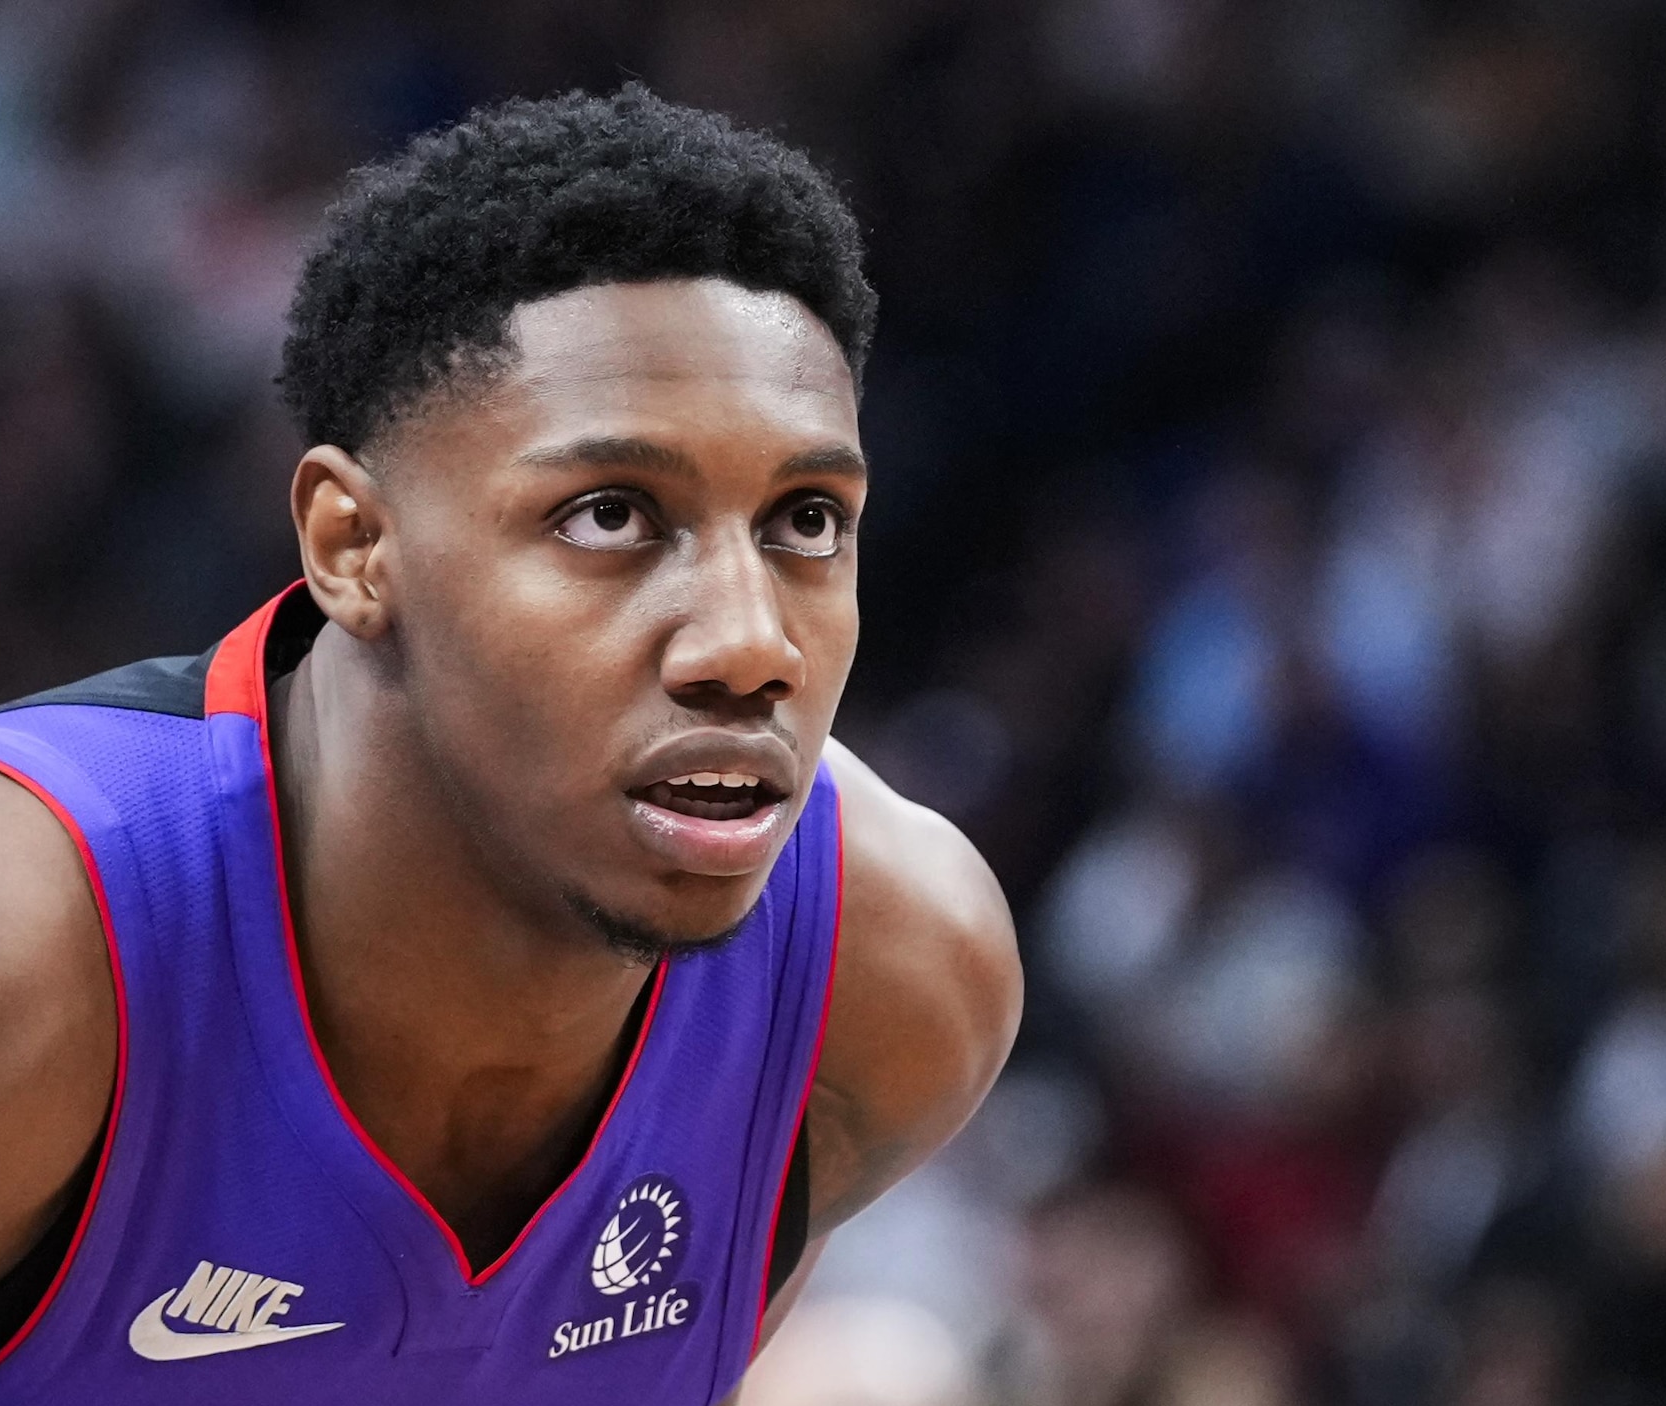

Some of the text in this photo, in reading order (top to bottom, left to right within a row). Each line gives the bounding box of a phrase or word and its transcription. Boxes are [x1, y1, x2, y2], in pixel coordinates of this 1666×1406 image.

[166, 1259, 305, 1332] NIKE
[548, 1288, 689, 1358] Sun Life
